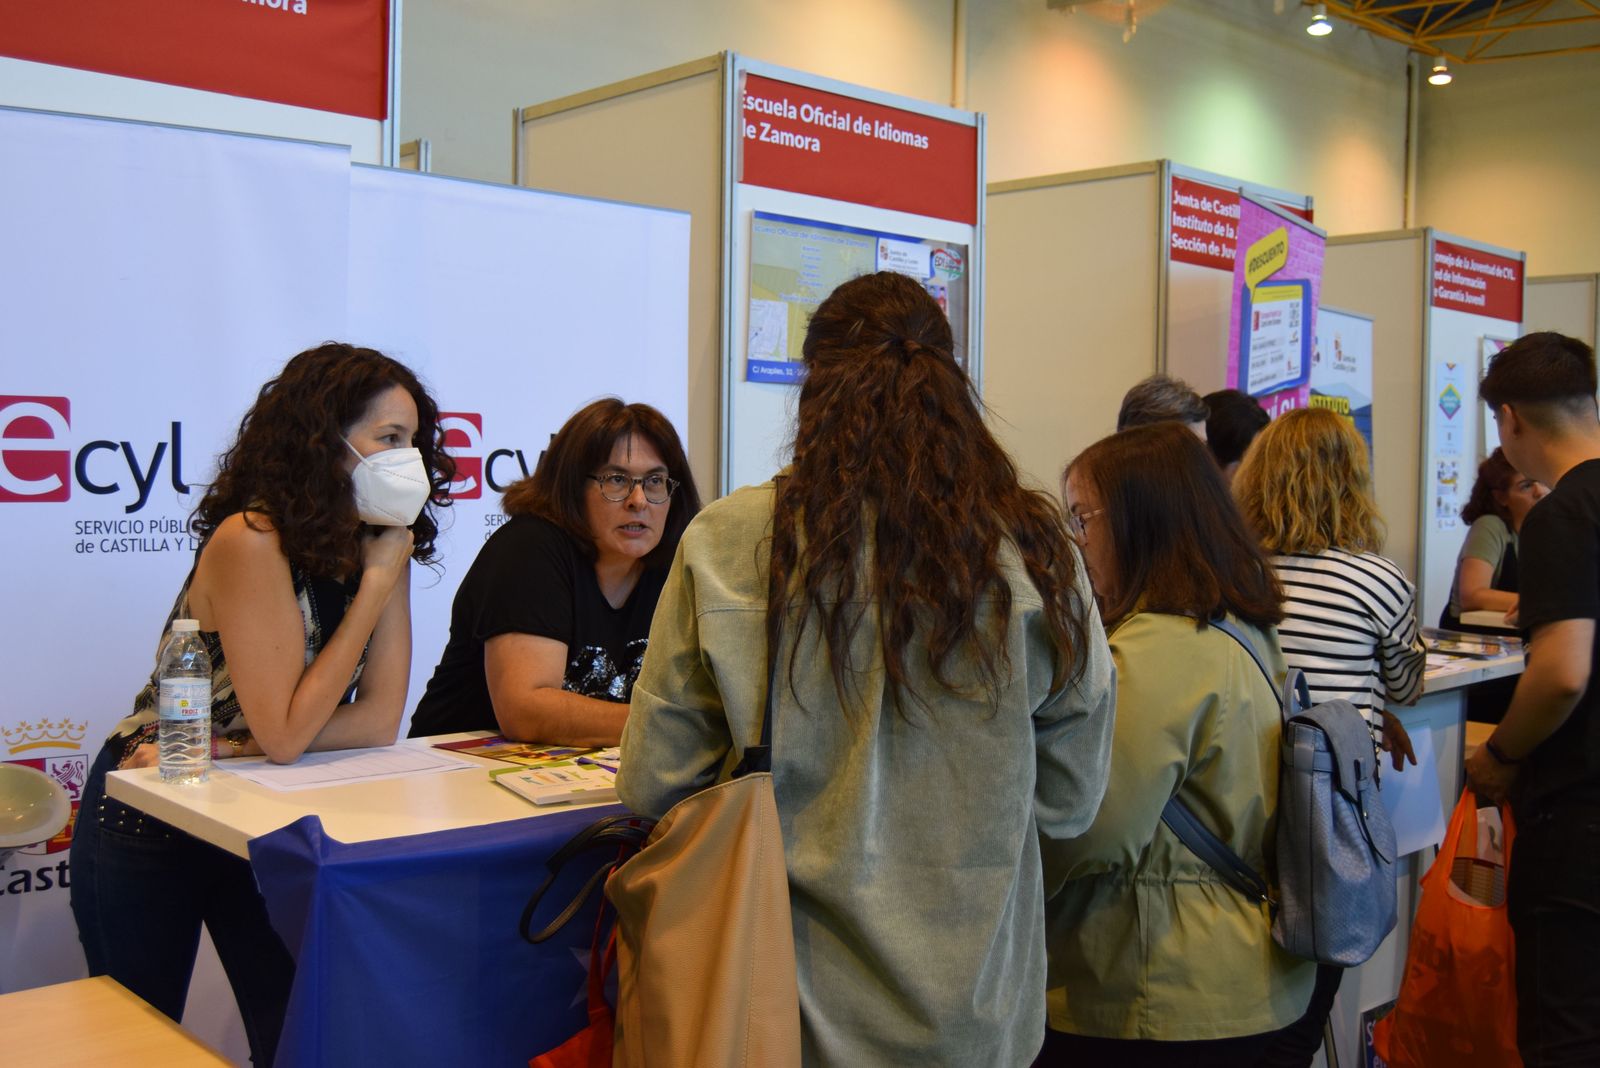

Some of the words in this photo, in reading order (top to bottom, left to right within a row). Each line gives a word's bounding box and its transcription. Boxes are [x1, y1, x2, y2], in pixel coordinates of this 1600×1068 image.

[743, 89, 797, 120] scuela
[800, 103, 851, 132] Oficial
[853, 115, 871, 136] de
[874, 119, 929, 150] Idiomas
[759, 121, 821, 153] Zamora
[1173, 190, 1200, 209] Junta
[1200, 196, 1213, 212] de
[1172, 211, 1213, 234] Instituto
[1214, 221, 1225, 236] de
[1226, 223, 1234, 239] la
[1172, 233, 1207, 254] Sección
[1208, 241, 1220, 256] de
[75, 519, 144, 535] SERVICIO
[75, 538, 95, 554] de
[100, 538, 170, 553] CASTILLA
[175, 537, 184, 551] Y
